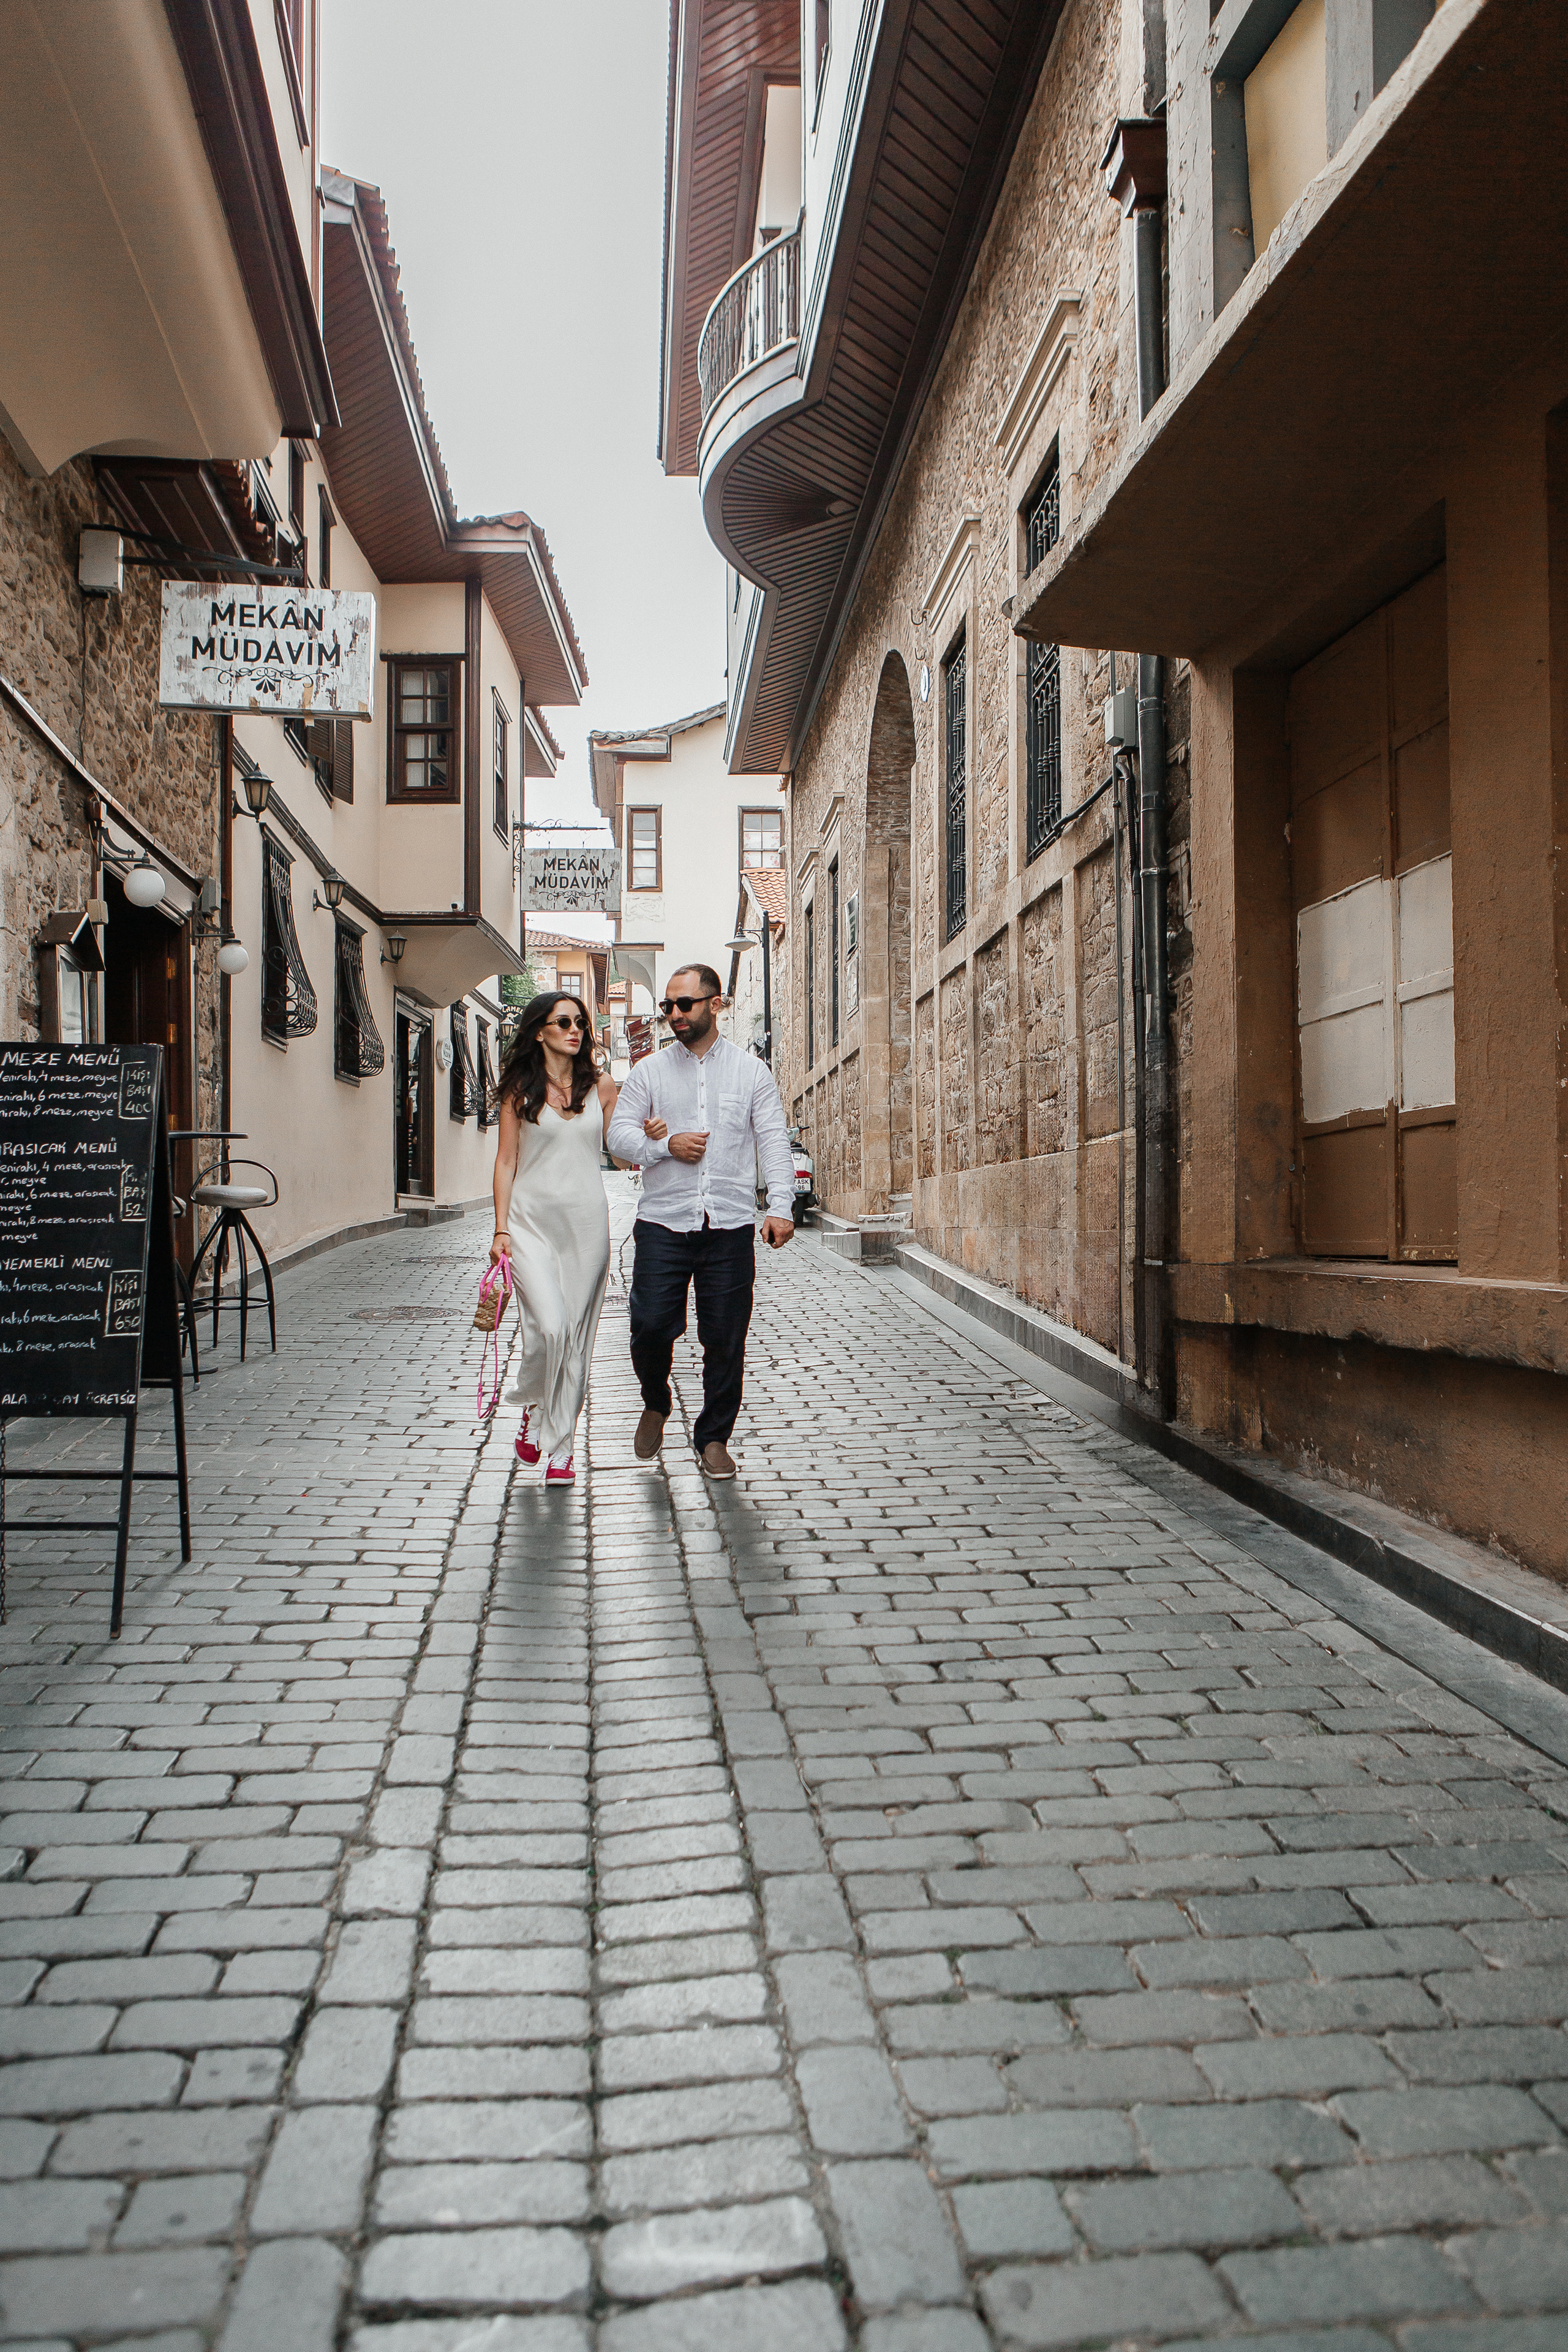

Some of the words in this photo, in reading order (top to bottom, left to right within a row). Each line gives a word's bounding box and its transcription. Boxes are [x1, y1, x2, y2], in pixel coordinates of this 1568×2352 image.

[211, 598, 324, 631] MEKÂN
[191, 631, 341, 666] MÜDAVİM
[543, 854, 600, 871] MEKÂN
[534, 873, 608, 889] MÜDAVİM
[502, 1003, 524, 1015] CAMEL
[1, 1051, 62, 1066] MEZE
[67, 1047, 121, 1066] MENÜ
[38, 1090, 45, 1101] 6
[33, 1104, 42, 1115] 8
[74, 1137, 118, 1154] MENÜ
[42, 1161, 50, 1172] 4
[30, 1188, 37, 1200] 6
